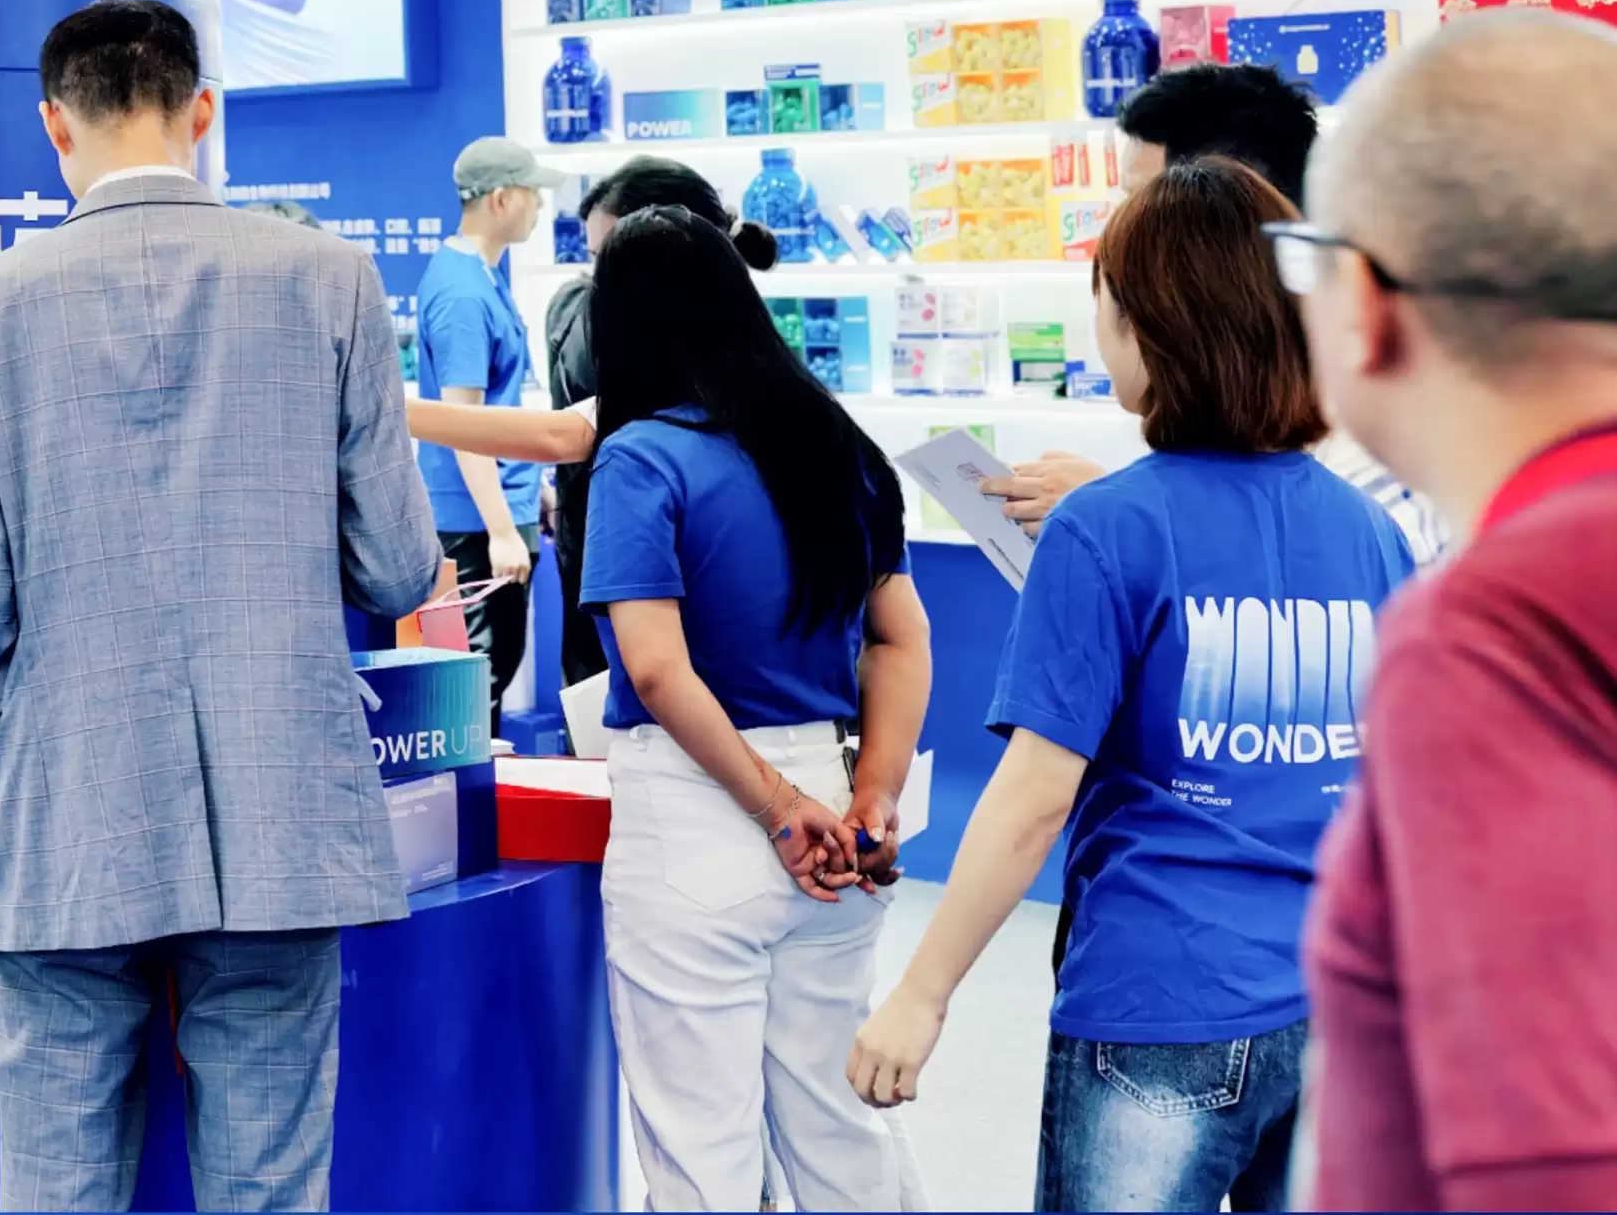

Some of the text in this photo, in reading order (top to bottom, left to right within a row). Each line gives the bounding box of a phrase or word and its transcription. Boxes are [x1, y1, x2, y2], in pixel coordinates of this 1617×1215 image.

[627, 120, 692, 139] POWER
[451, 724, 483, 755] UP
[1178, 718, 1368, 764] WONDE
[1171, 779, 1216, 794] EXPLORE
[1192, 794, 1232, 806] WONDER
